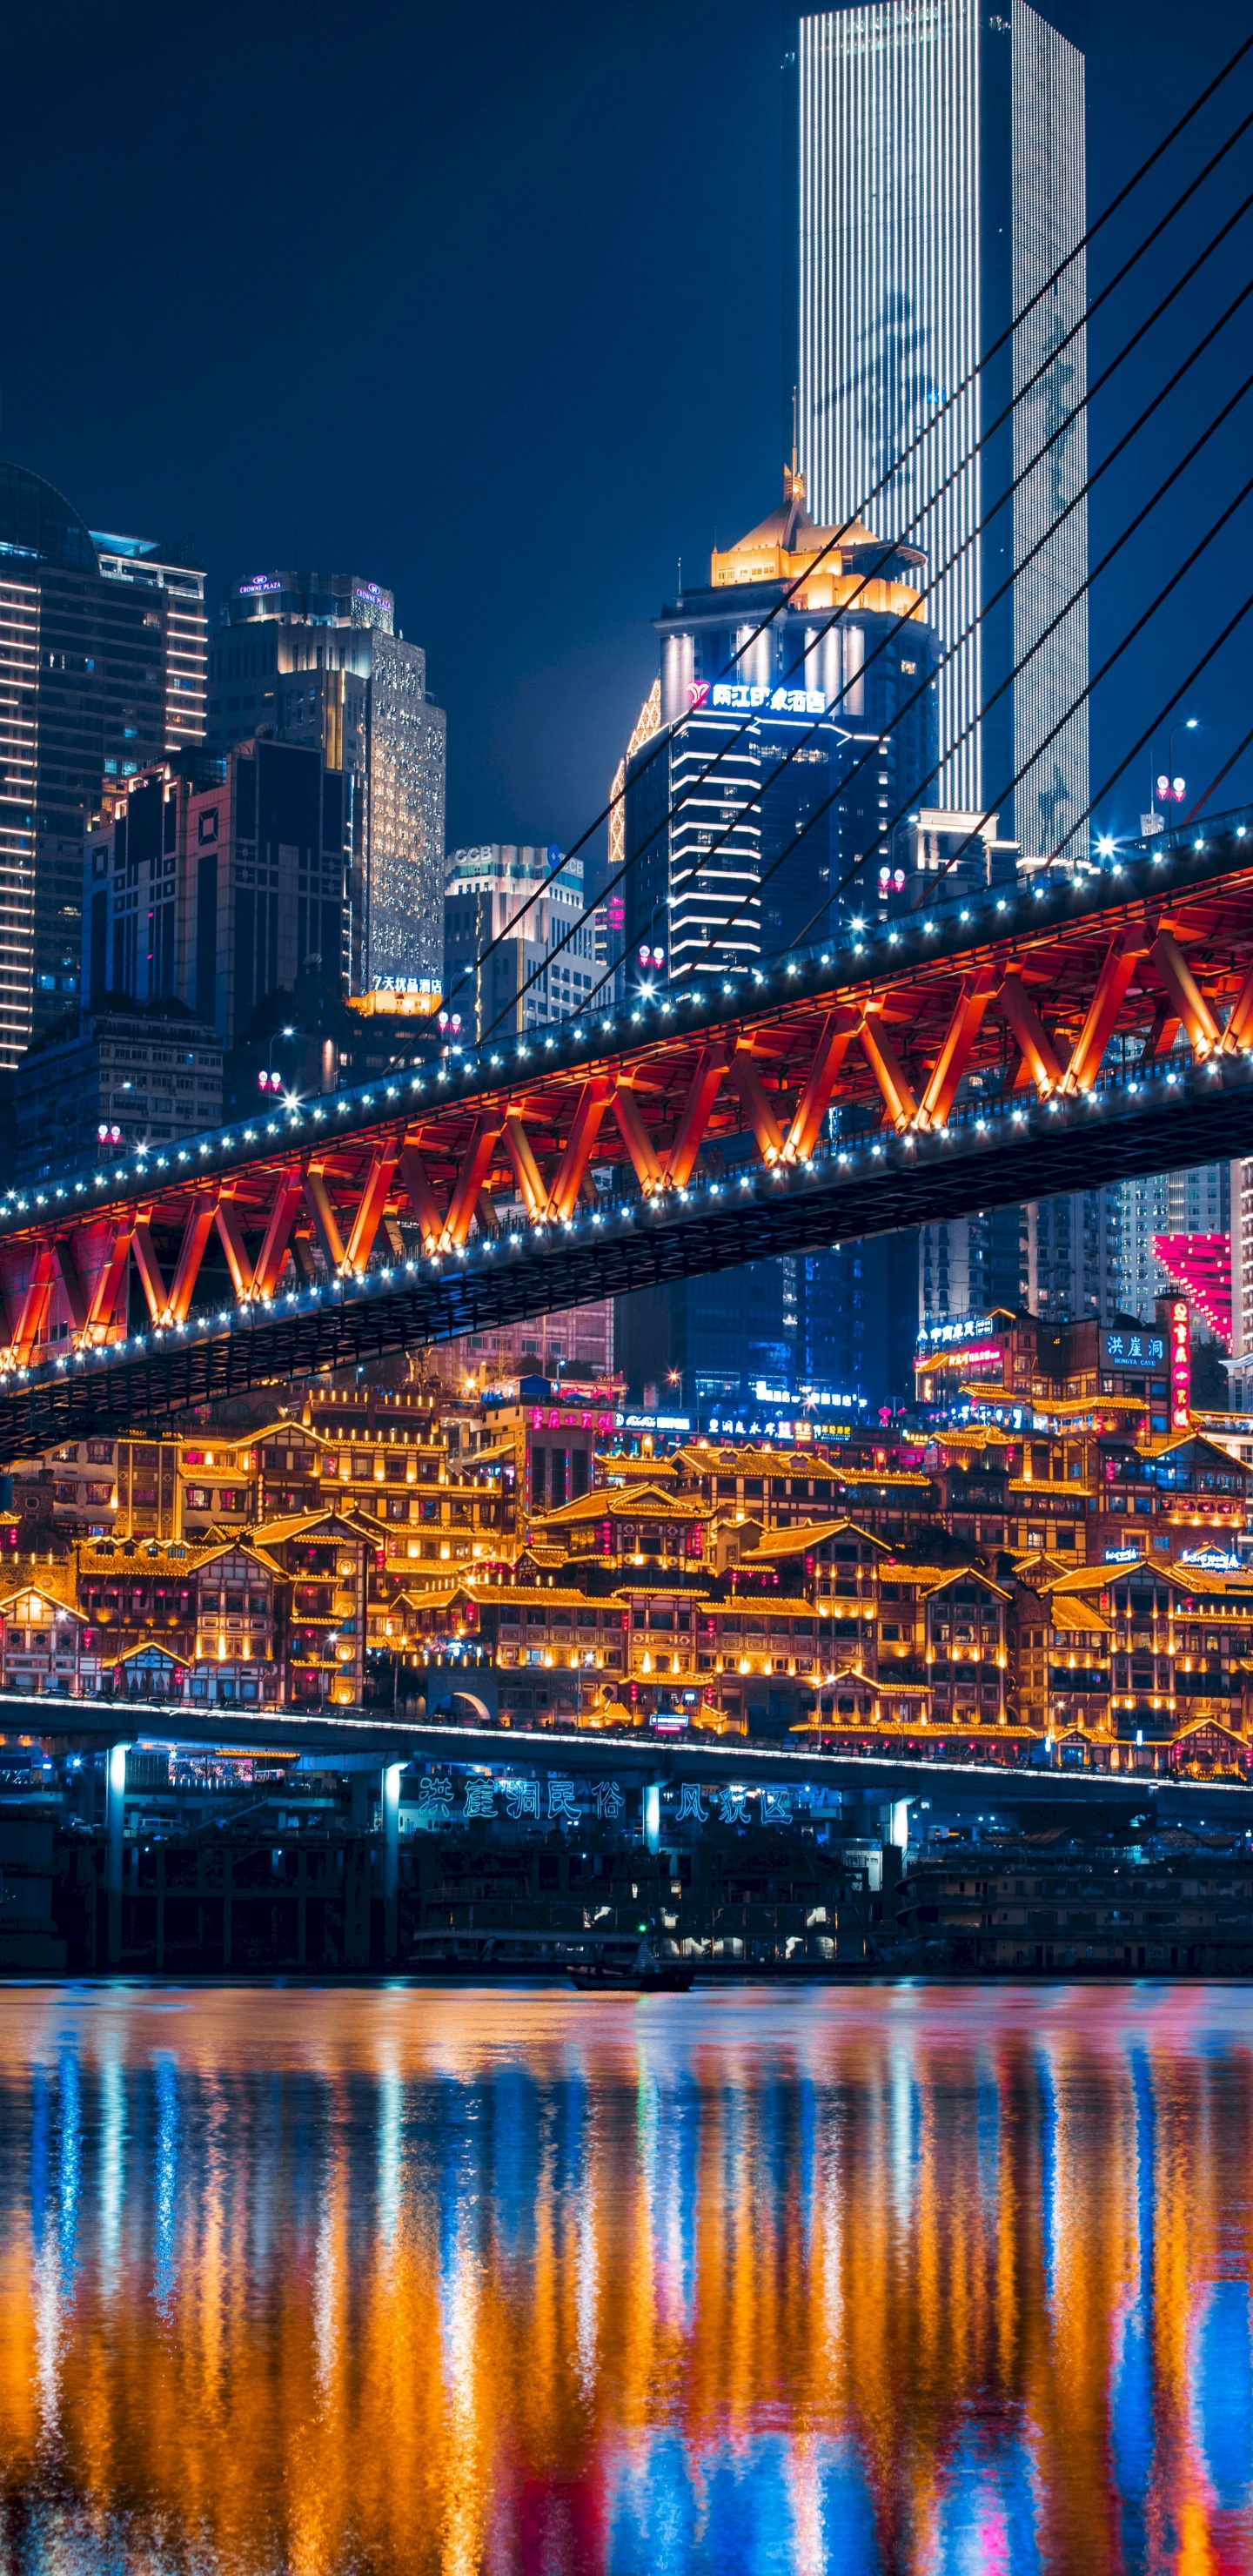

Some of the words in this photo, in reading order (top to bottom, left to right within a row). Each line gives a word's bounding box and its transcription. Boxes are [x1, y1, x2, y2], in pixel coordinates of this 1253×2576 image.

[239, 585, 262, 594] CROWNE
[356, 588, 376, 603] CROWNE
[376, 598, 392, 609] PLAZA
[455, 846, 492, 862] CCB
[372, 976, 442, 994] 7天优品酒店
[1106, 1335, 1163, 1359] 洪崖洞
